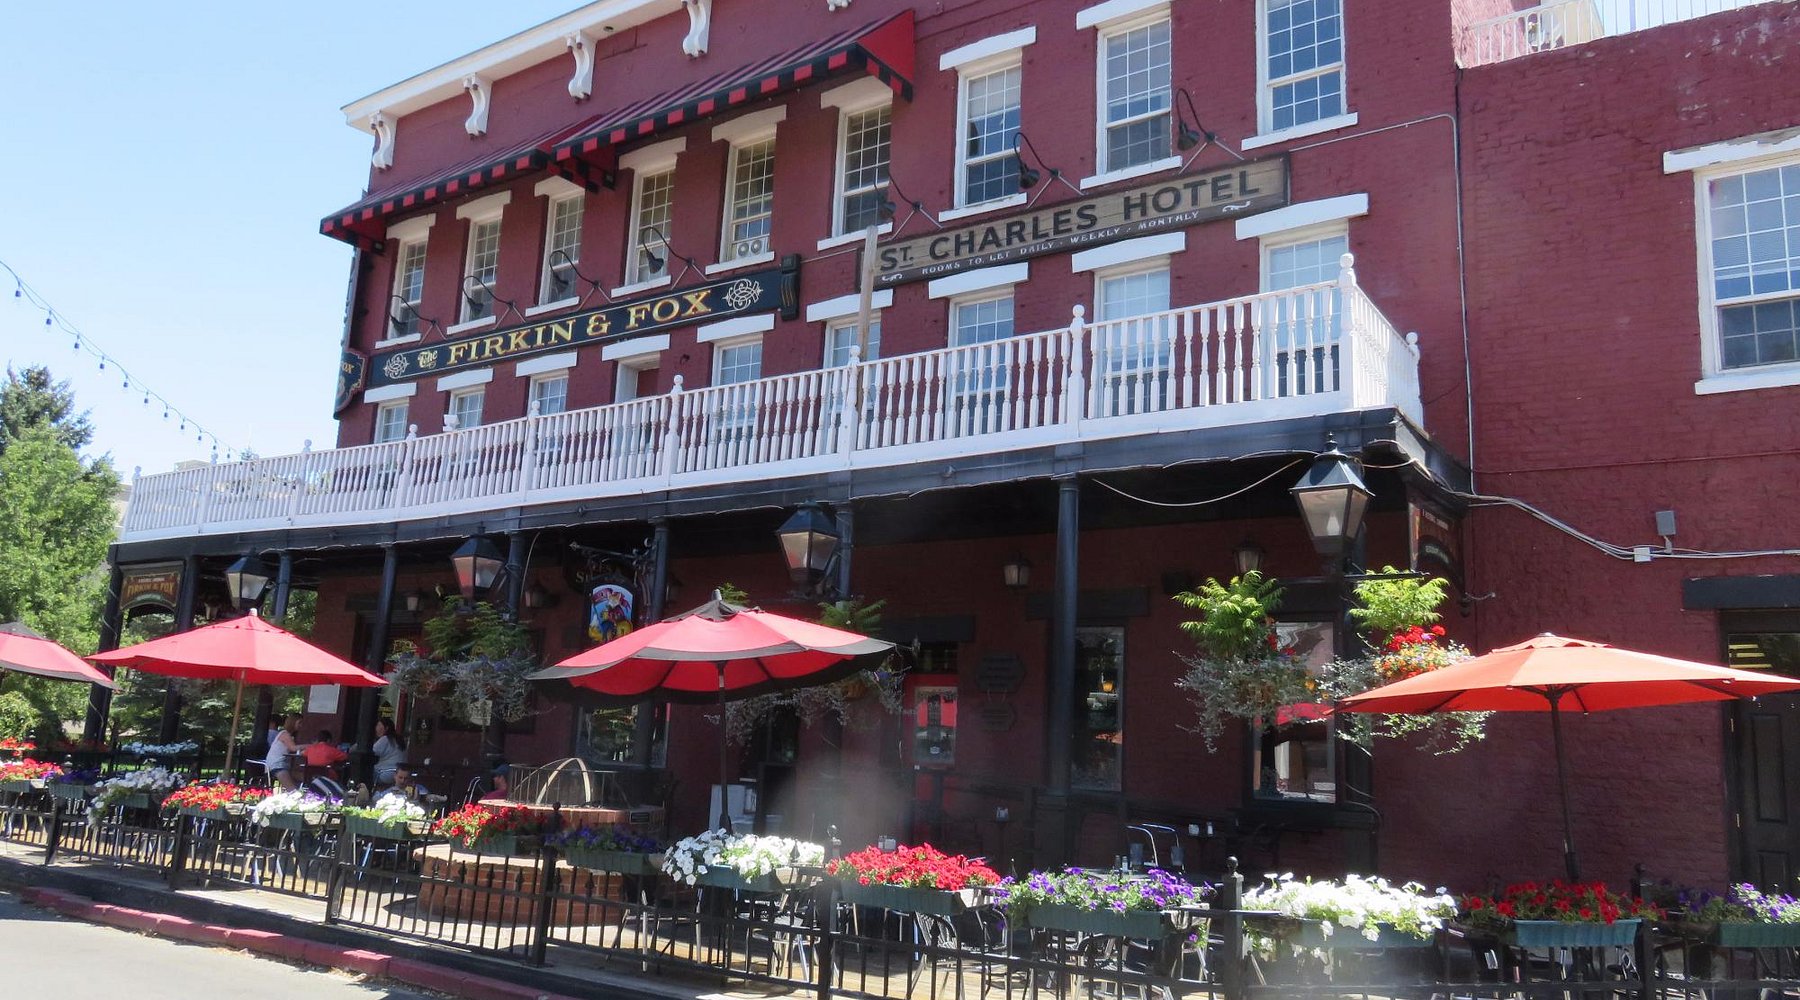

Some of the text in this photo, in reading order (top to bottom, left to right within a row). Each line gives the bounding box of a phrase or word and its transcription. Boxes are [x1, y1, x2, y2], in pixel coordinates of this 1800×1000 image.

[880, 170, 1259, 270] ST. CHARLES HOTEL
[922, 262, 961, 275] ROOMS
[989, 252, 1010, 262] LET
[1020, 242, 1055, 255] DAILY
[1070, 228, 1121, 244] WEEKLY
[1138, 210, 1200, 231] MONTHLY
[417, 289, 712, 369] The FIRKIN & FOX
